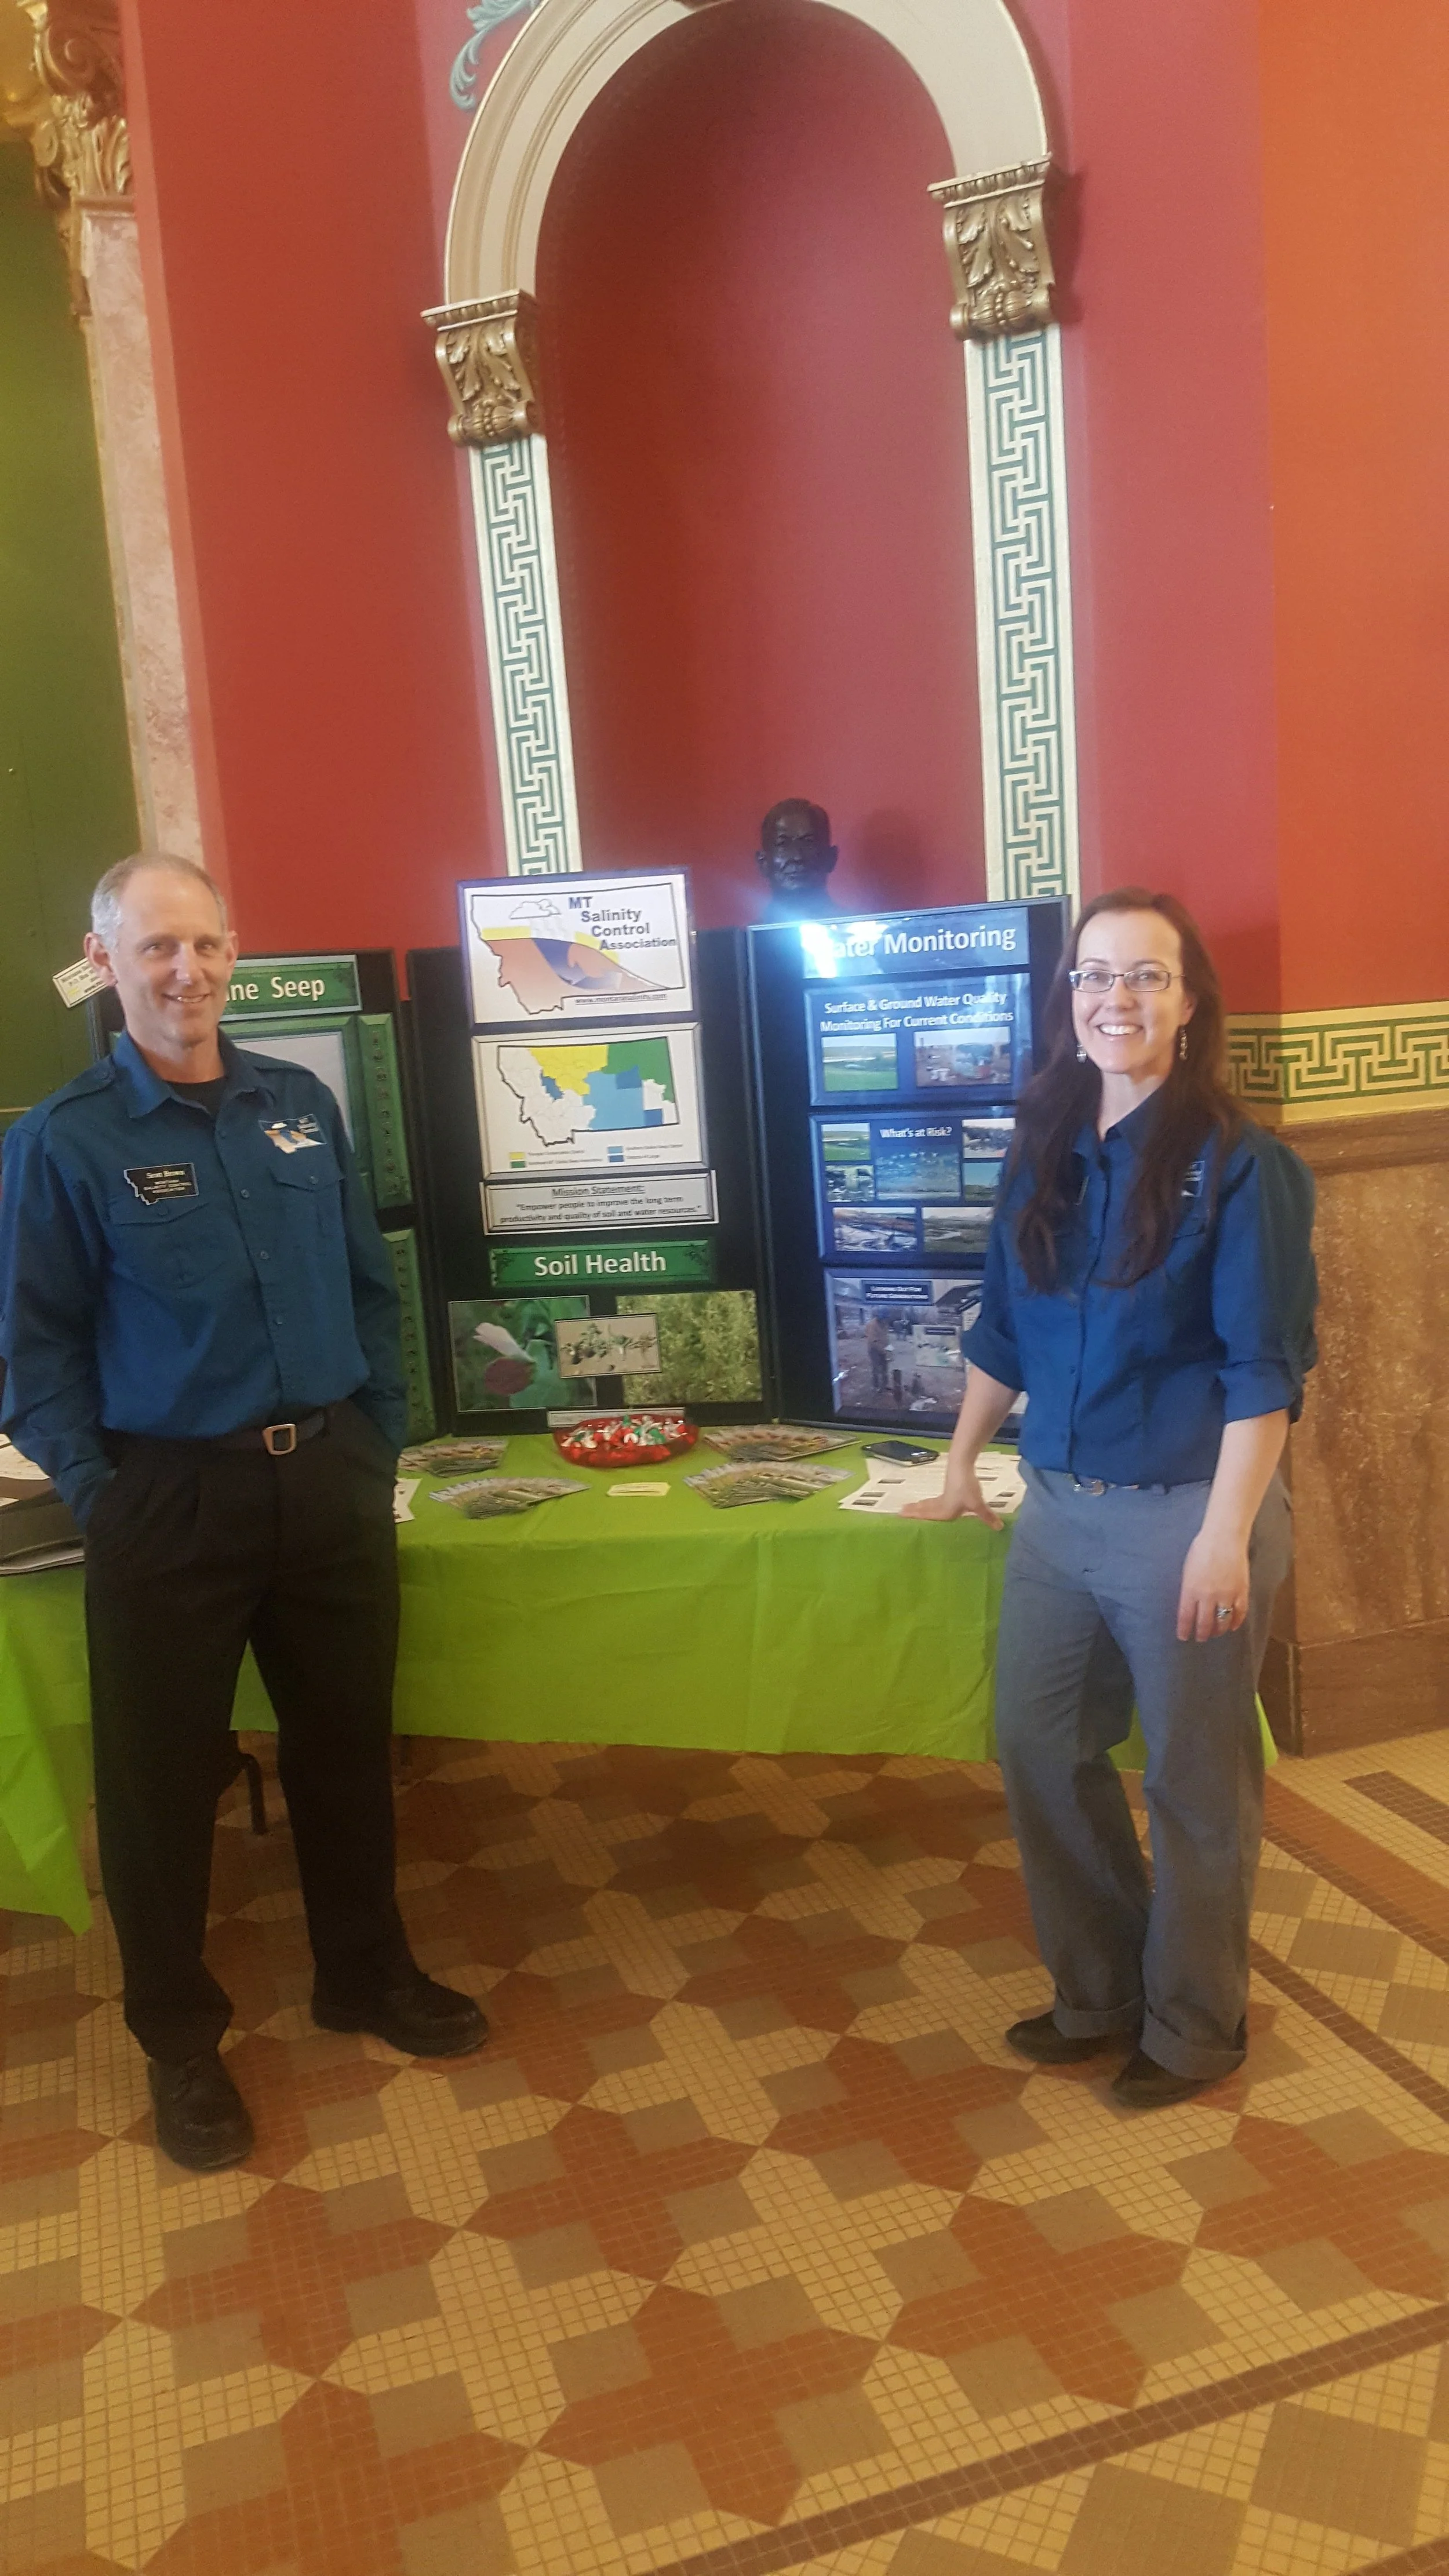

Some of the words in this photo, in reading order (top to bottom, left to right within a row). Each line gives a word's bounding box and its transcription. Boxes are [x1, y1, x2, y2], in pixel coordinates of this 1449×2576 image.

[568, 896, 593, 909] MT
[581, 908, 642, 922] Salinity
[591, 922, 650, 937] Control
[600, 937, 676, 951] Association
[820, 936, 876, 958] ater
[884, 925, 1016, 955] Monitoring
[226, 983, 259, 1001] ne
[270, 976, 325, 1002] Seep
[824, 1001, 865, 1014] Surface
[867, 999, 878, 1011] &
[879, 996, 922, 1010] Ground
[924, 995, 960, 1007] Water
[962, 992, 1007, 1006] Quality
[820, 1018, 882, 1032] Monitoring
[883, 1017, 902, 1028] For
[903, 1014, 948, 1027] Current
[949, 1011, 1014, 1025] Conditions
[880, 1127, 914, 1138] What's
[915, 1129, 926, 1137] at
[926, 1126, 953, 1137] Risk?
[552, 1188, 590, 1198] Mission
[500, 1215, 545, 1224] productivity
[565, 1212, 591, 1220] quality
[534, 1253, 578, 1276] Soil
[585, 1250, 667, 1275] Health
